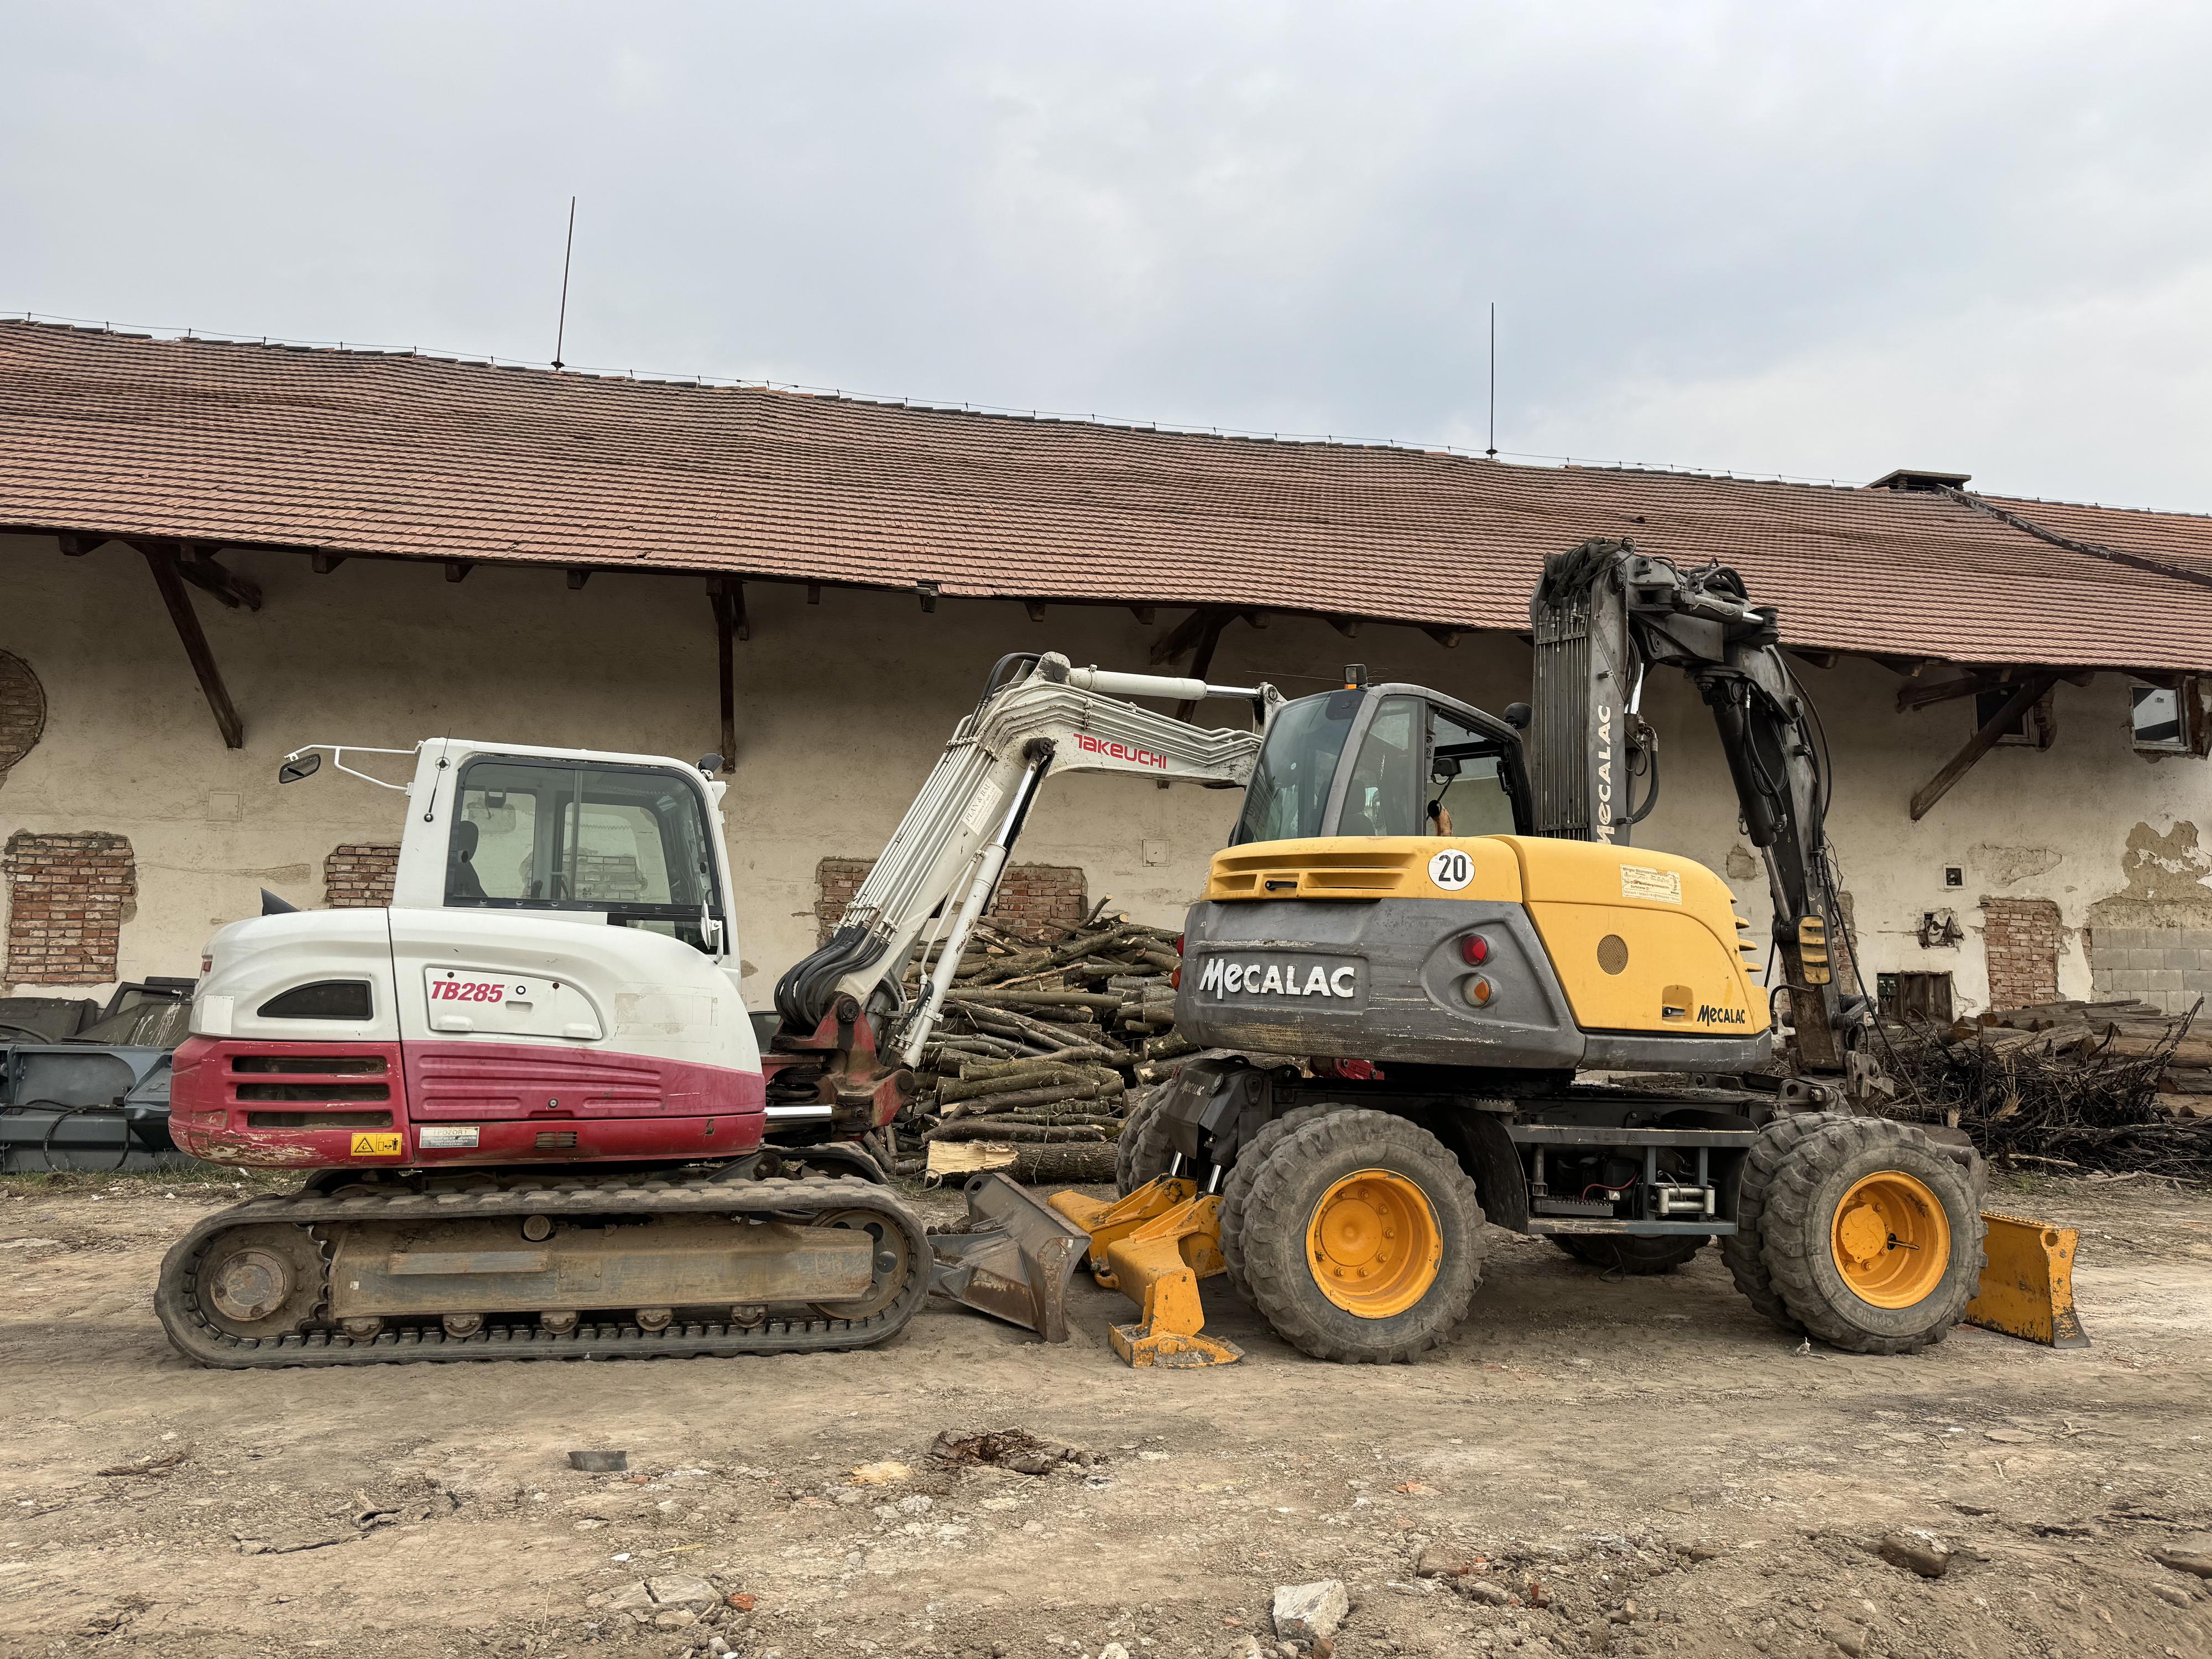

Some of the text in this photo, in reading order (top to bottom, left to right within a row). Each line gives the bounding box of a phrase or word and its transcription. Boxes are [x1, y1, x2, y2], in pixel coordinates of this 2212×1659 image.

[966, 802, 978, 822] PLAN
[980, 781, 992, 797] BAU
[1438, 854, 1466, 881] 20
[431, 980, 505, 1003] TB285
